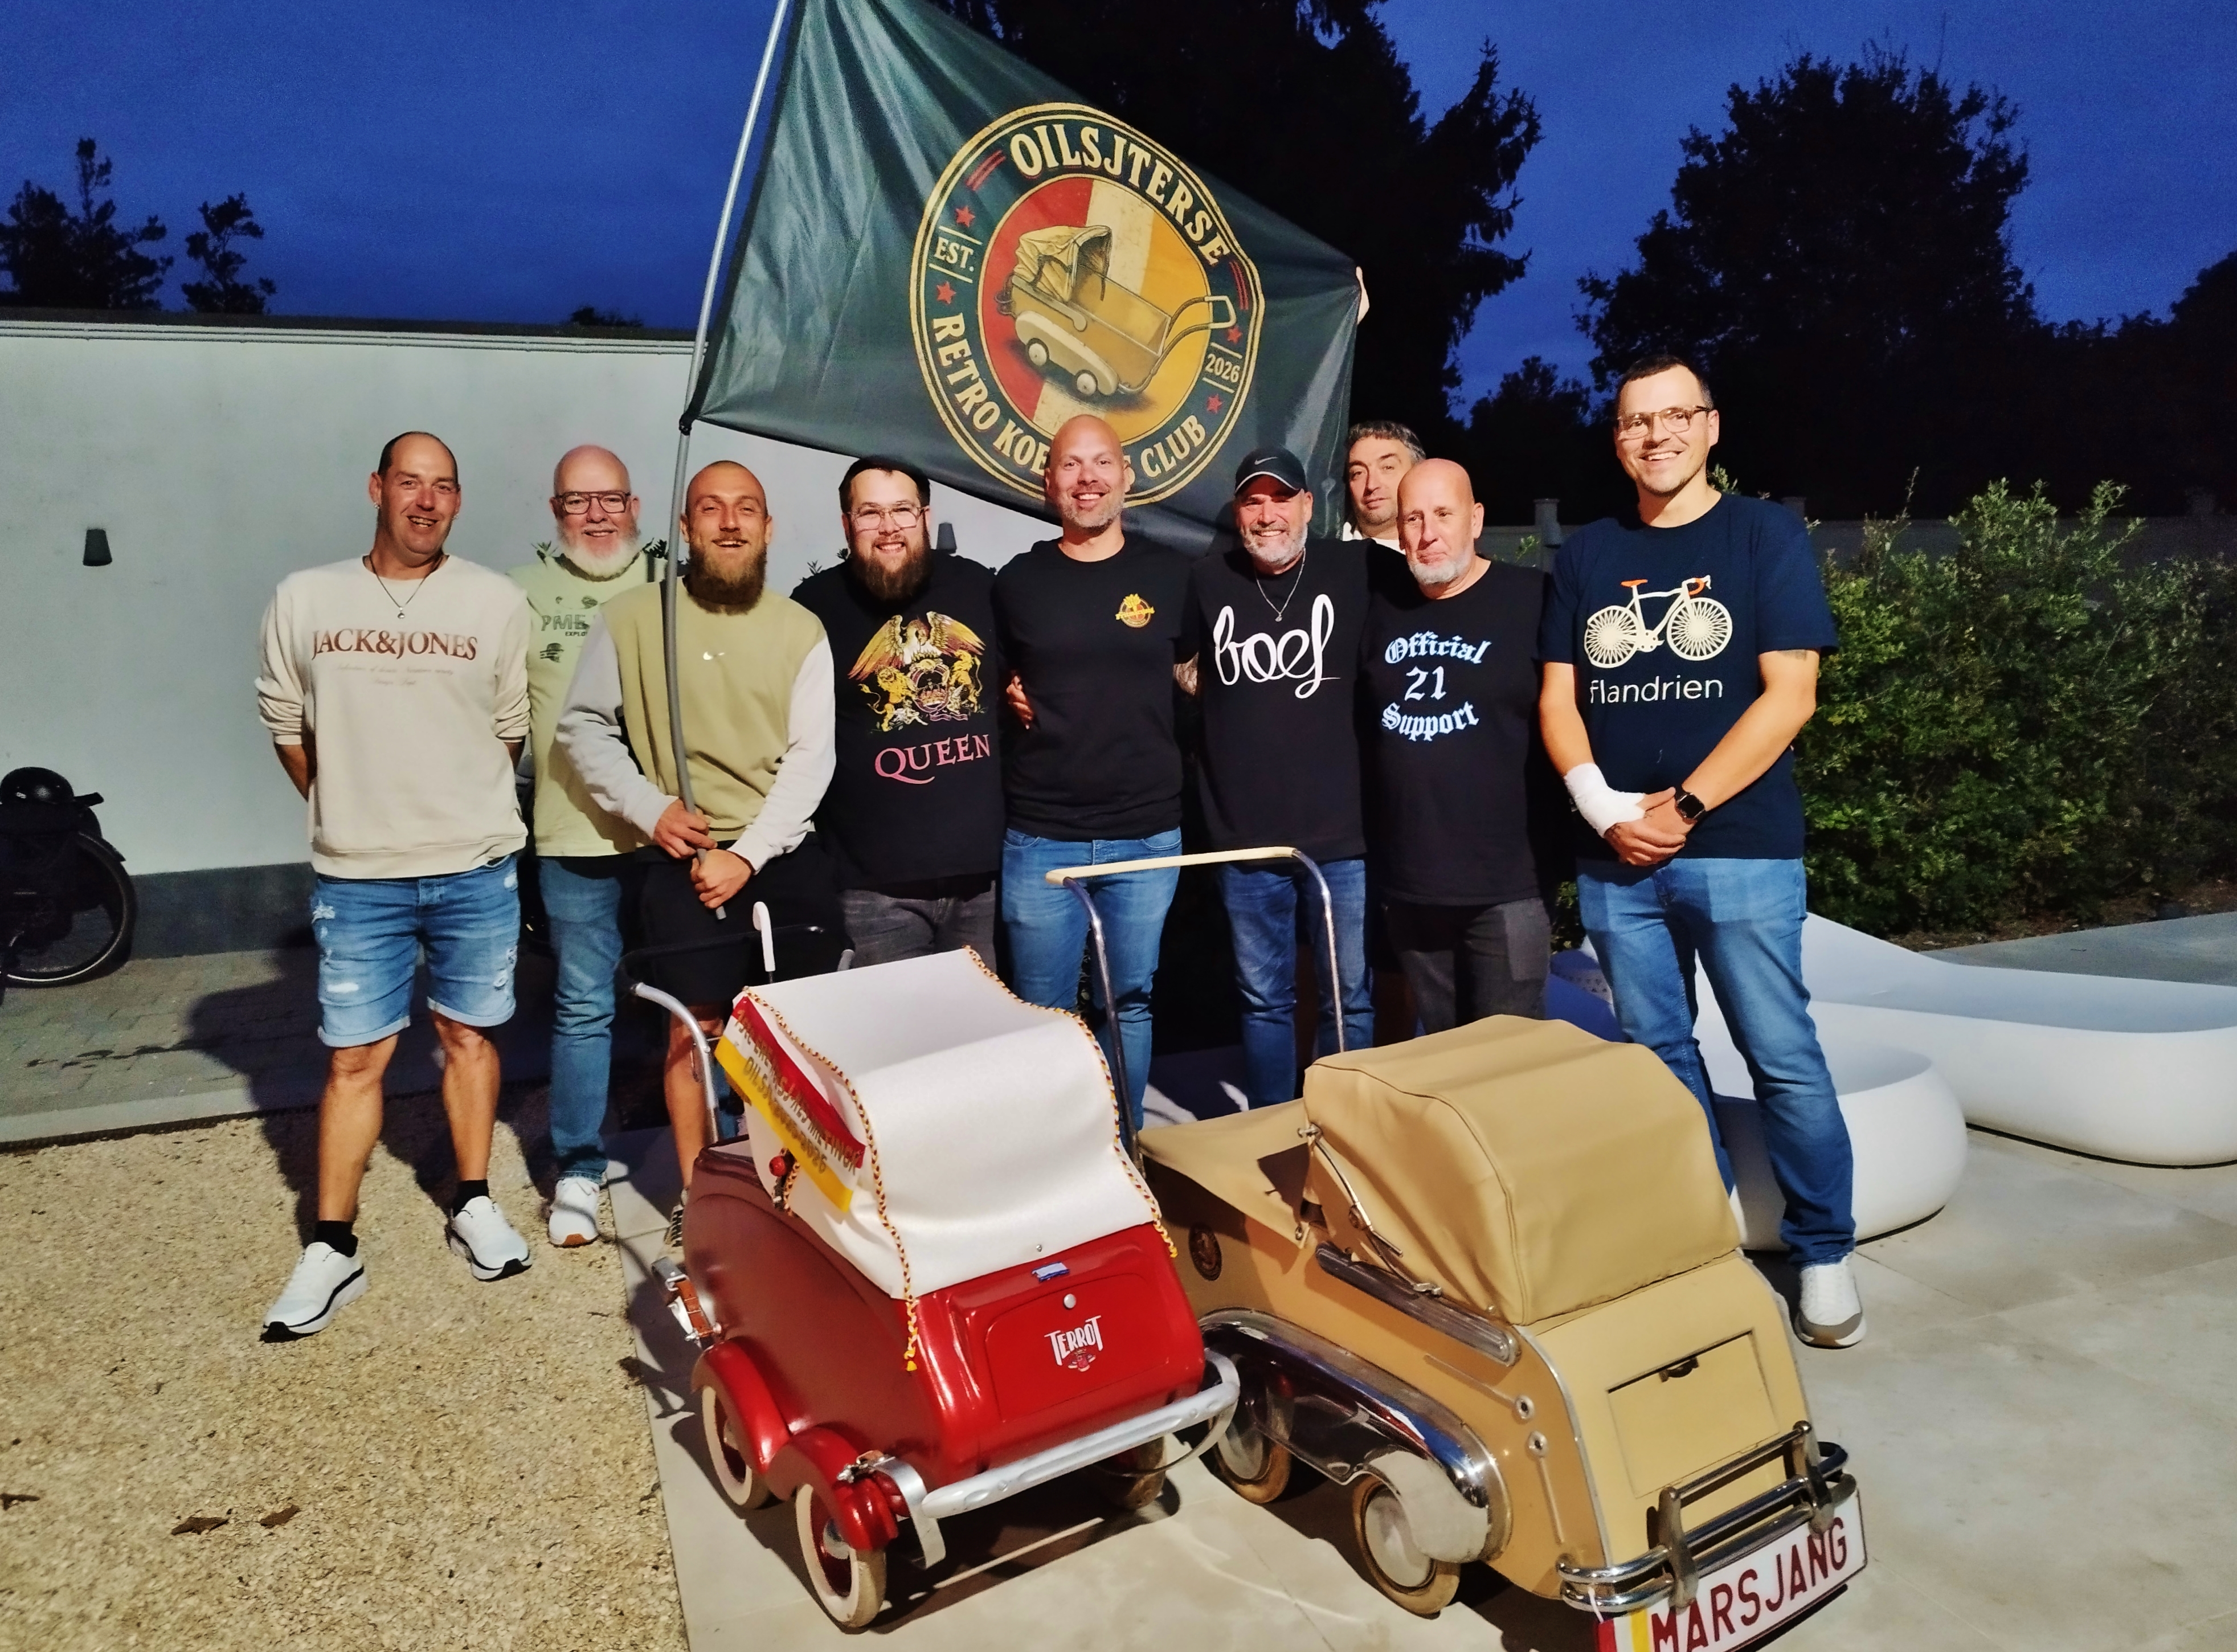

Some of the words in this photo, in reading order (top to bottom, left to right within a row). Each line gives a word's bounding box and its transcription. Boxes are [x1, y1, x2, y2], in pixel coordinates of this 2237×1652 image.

[1010, 123, 1230, 265] OILSJTERSE
[934, 237, 974, 272] EST.
[1207, 353, 1240, 383] 2026
[933, 313, 1000, 431] RETRO
[1140, 414, 1207, 479] CLUB
[311, 628, 478, 661] JACK&JONES
[1384, 630, 1492, 665] Official
[1404, 665, 1447, 702] 21
[1590, 674, 1723, 704] flandrien
[1381, 701, 1479, 742] Support
[874, 734, 991, 784] QUEEN
[1044, 1315, 1103, 1366] TERROT
[1652, 1516, 1848, 1652] MARSJANG
